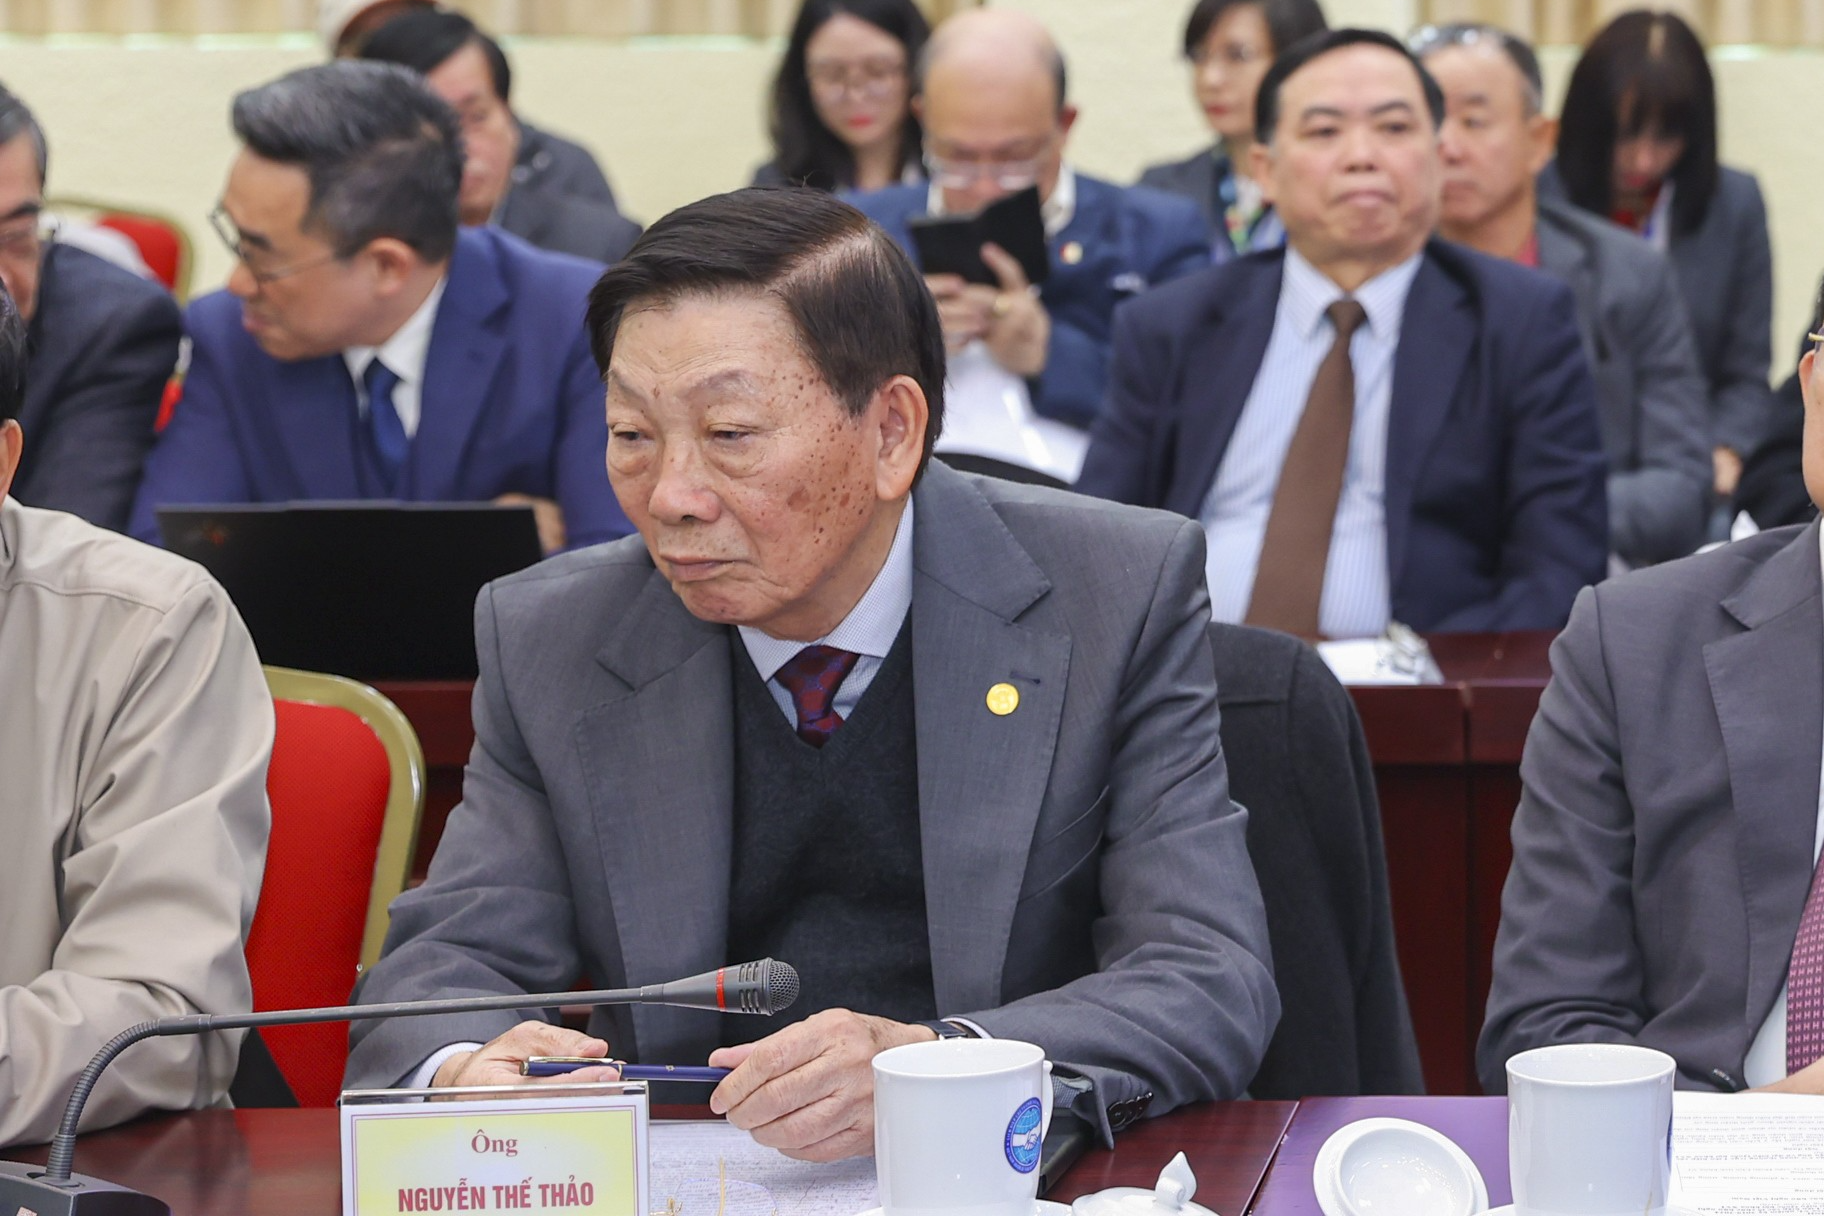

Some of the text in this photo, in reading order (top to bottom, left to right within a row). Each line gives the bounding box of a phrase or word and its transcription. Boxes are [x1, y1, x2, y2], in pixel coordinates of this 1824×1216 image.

[471, 1128, 518, 1158] Ông
[398, 1174, 594, 1213] NGUYỄN THẾ THẢO
